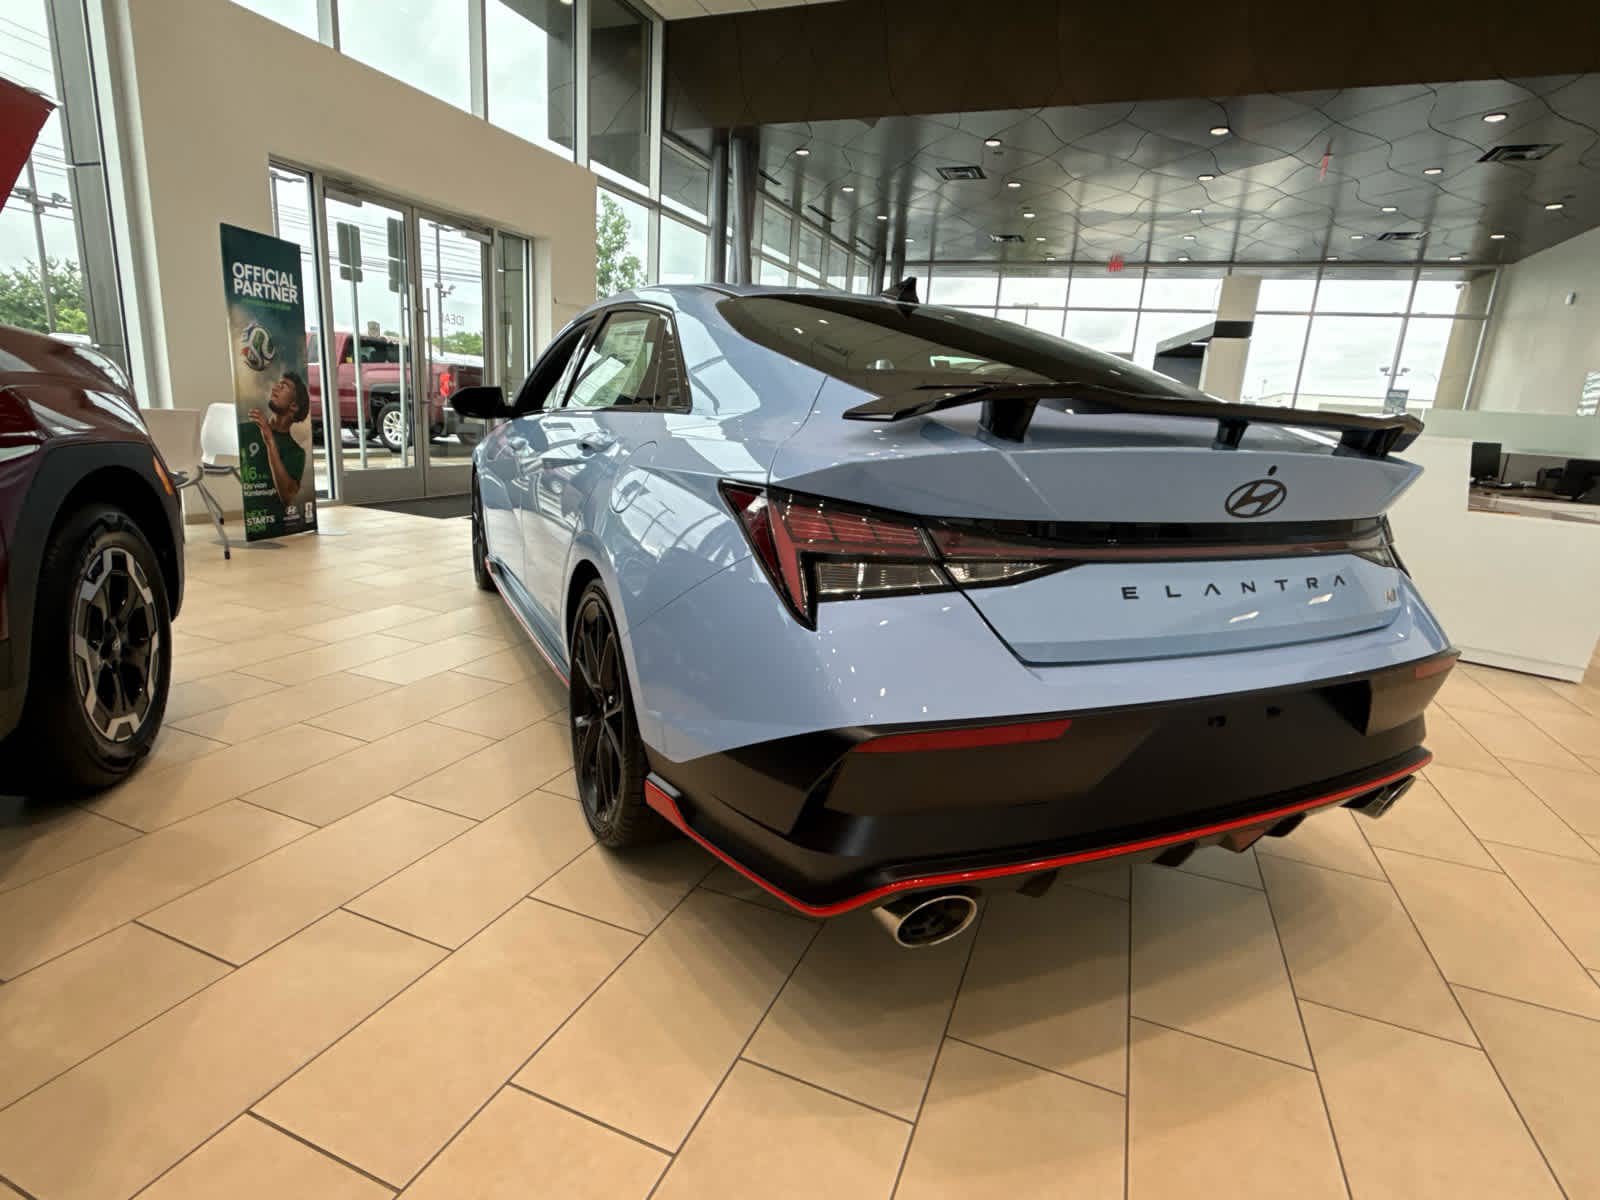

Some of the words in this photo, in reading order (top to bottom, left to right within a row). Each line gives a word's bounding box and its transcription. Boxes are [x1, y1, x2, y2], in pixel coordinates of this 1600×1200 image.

[232, 262, 297, 289] OFFICIAL
[233, 279, 299, 304] PARTNER
[246, 515, 275, 526] STARTS
[1121, 575, 1347, 600] ELANTRA
